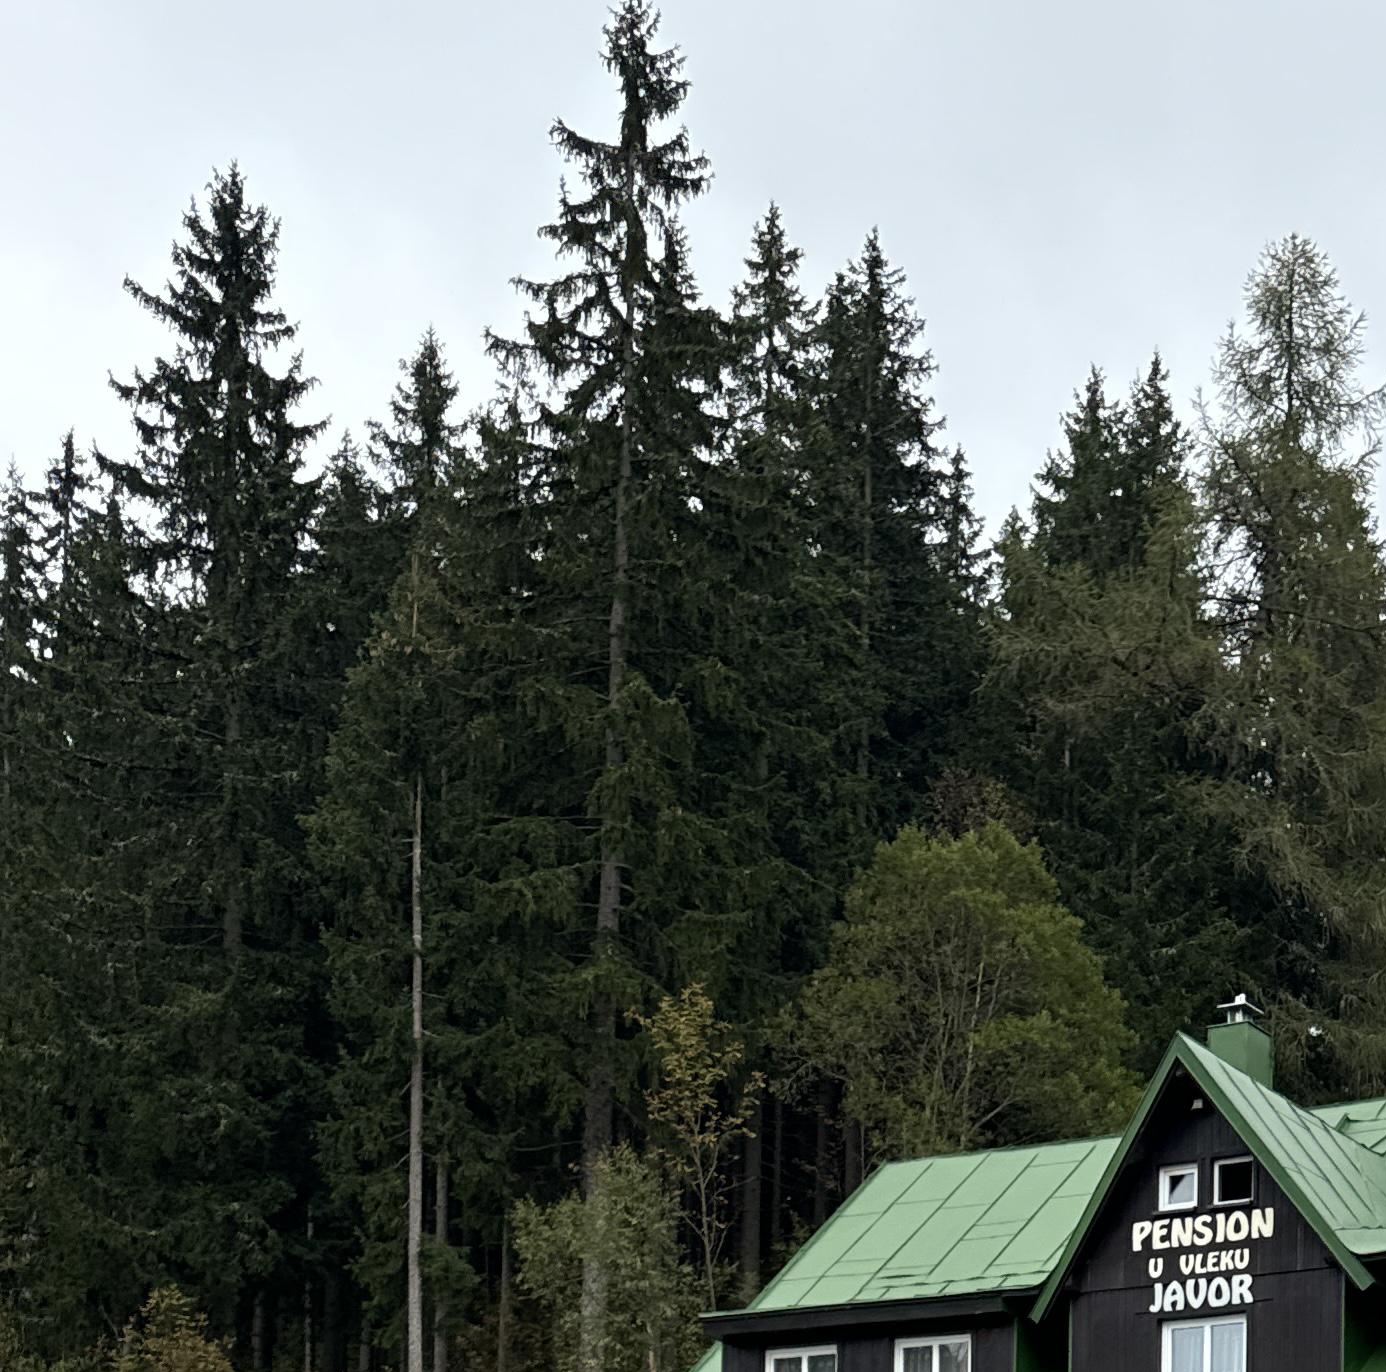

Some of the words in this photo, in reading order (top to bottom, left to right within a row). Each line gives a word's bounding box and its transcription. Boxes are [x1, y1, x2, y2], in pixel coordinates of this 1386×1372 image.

[1132, 1207, 1275, 1252] PENSION
[1148, 1257, 1164, 1279] U
[1179, 1248, 1250, 1276] VLEKU
[1149, 1273, 1254, 1313] JAVOR
